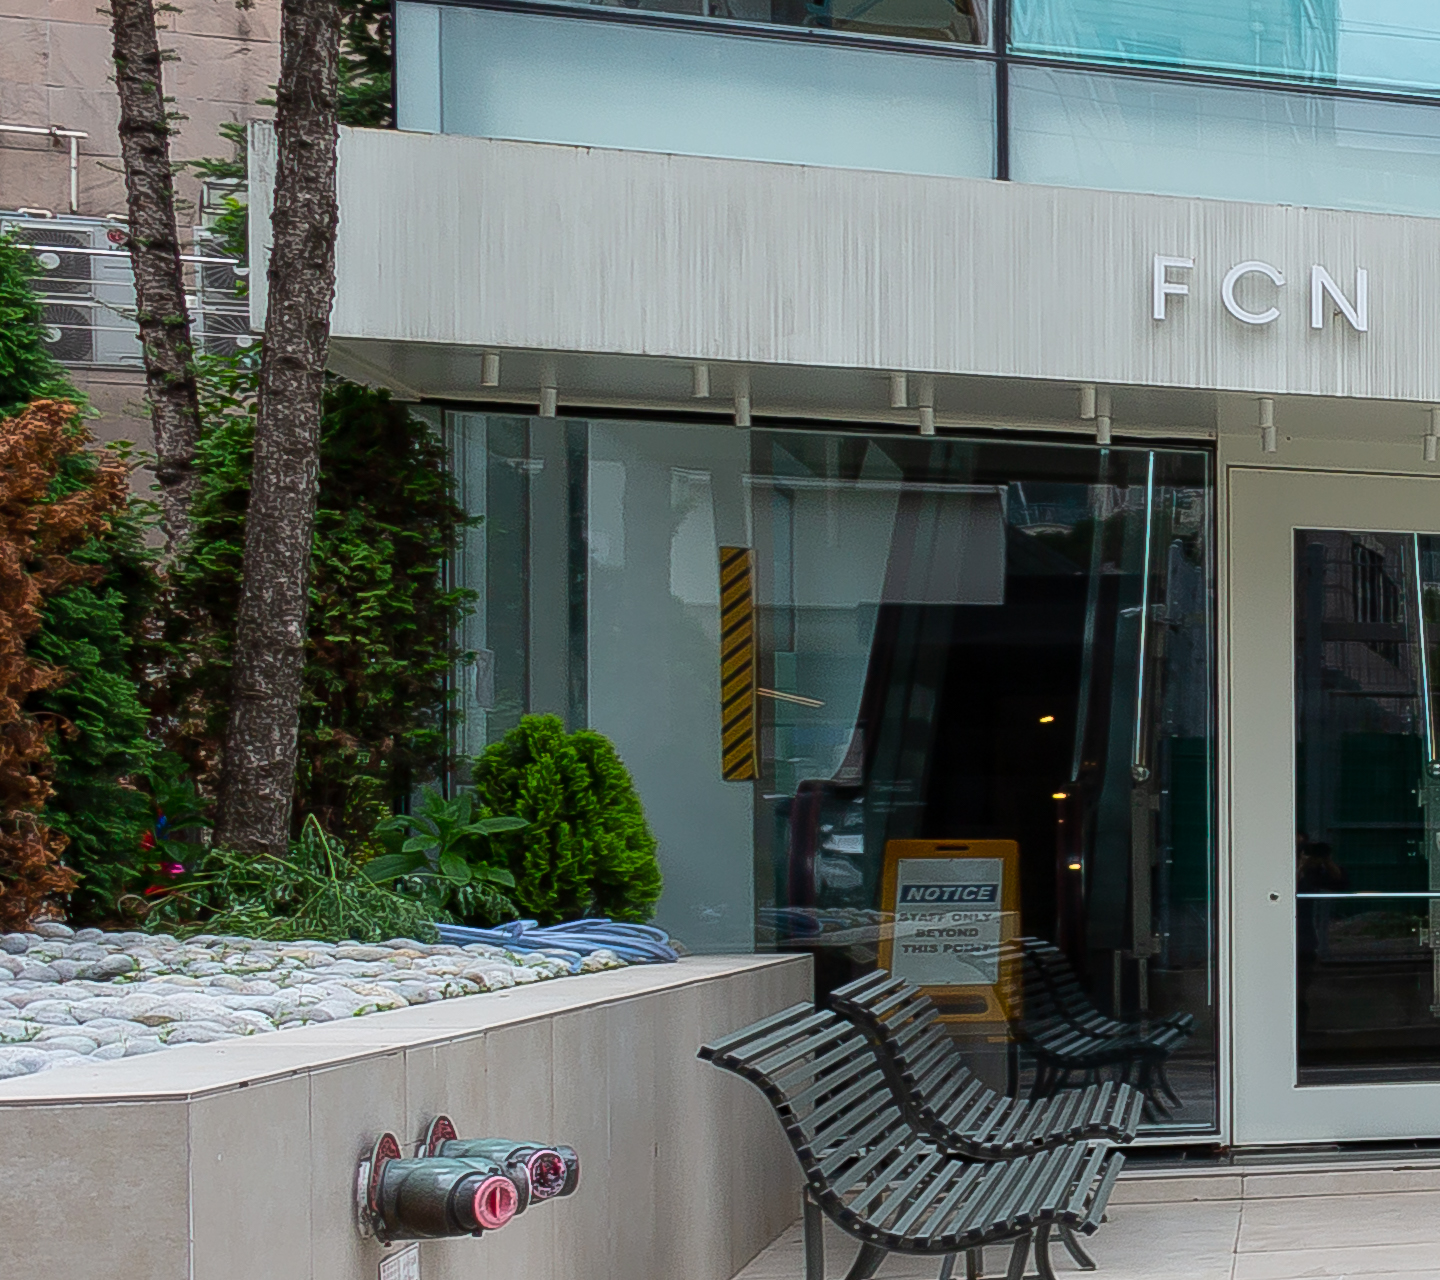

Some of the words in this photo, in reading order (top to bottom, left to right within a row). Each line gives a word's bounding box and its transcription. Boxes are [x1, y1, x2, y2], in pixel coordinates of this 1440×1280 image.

[1152, 253, 1370, 333] FCN
[906, 886, 993, 900] NOTICE
[898, 912, 945, 922] STAFF
[951, 913, 992, 922] ONLY
[915, 928, 979, 938] BEYOND
[901, 944, 939, 953] THIS
